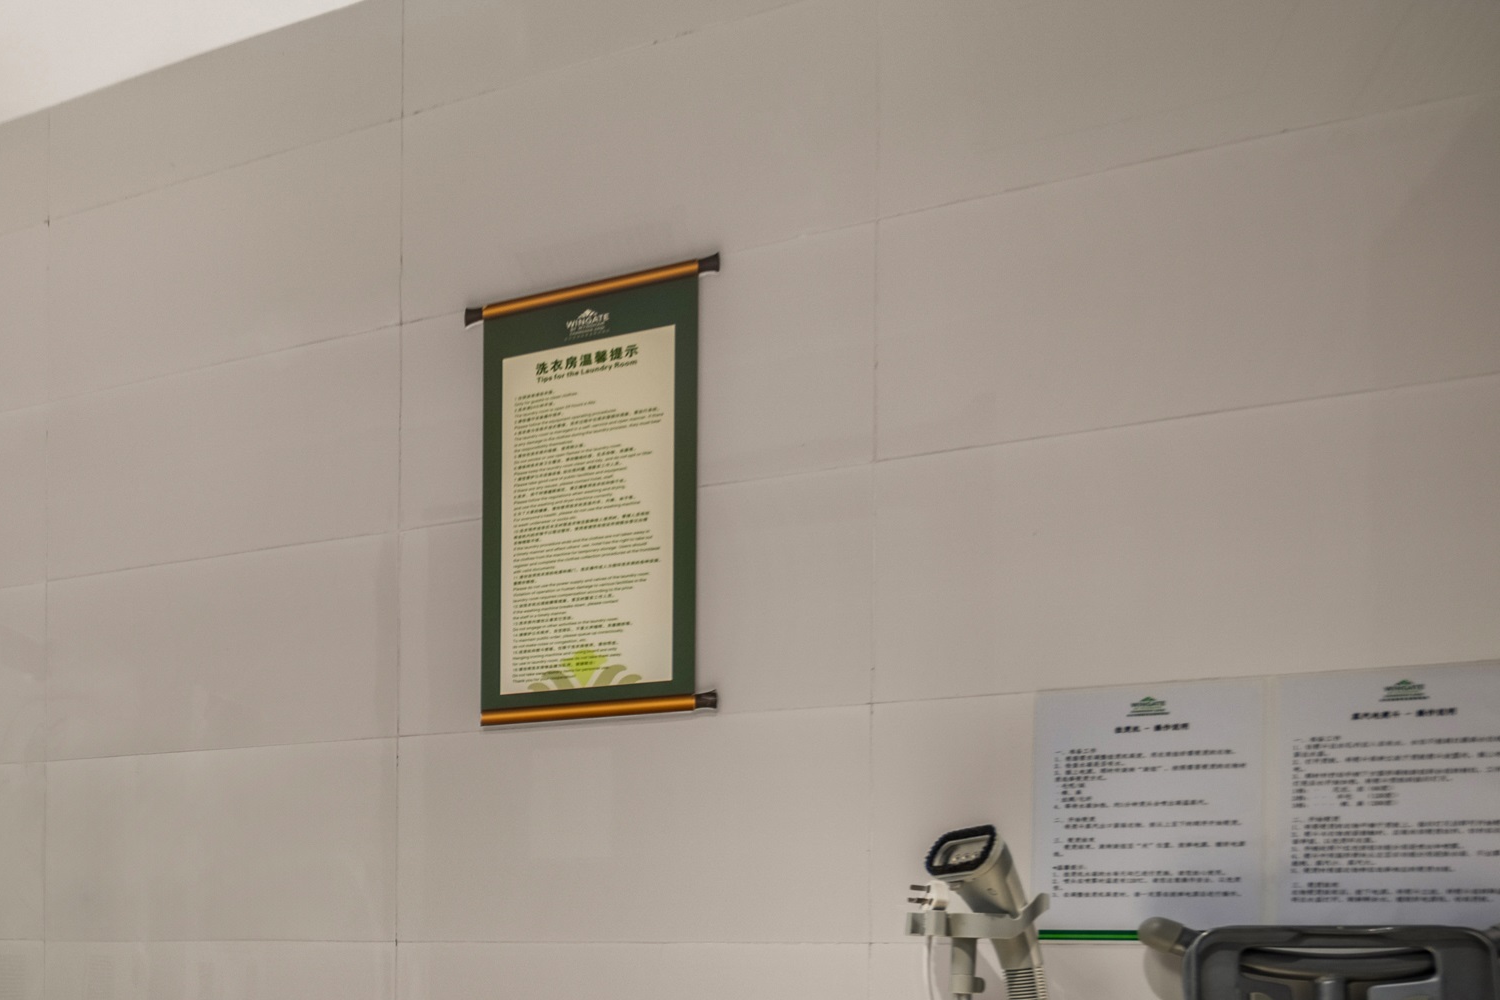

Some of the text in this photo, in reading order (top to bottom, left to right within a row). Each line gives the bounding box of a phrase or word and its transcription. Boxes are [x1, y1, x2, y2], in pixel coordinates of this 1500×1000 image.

[566, 312, 610, 329] WINGATE
[535, 344, 639, 376] 洗衣房温馨提示
[536, 376, 553, 384] Tips
[566, 370, 579, 378] the
[580, 364, 613, 375] Laundry
[614, 360, 638, 368] Room
